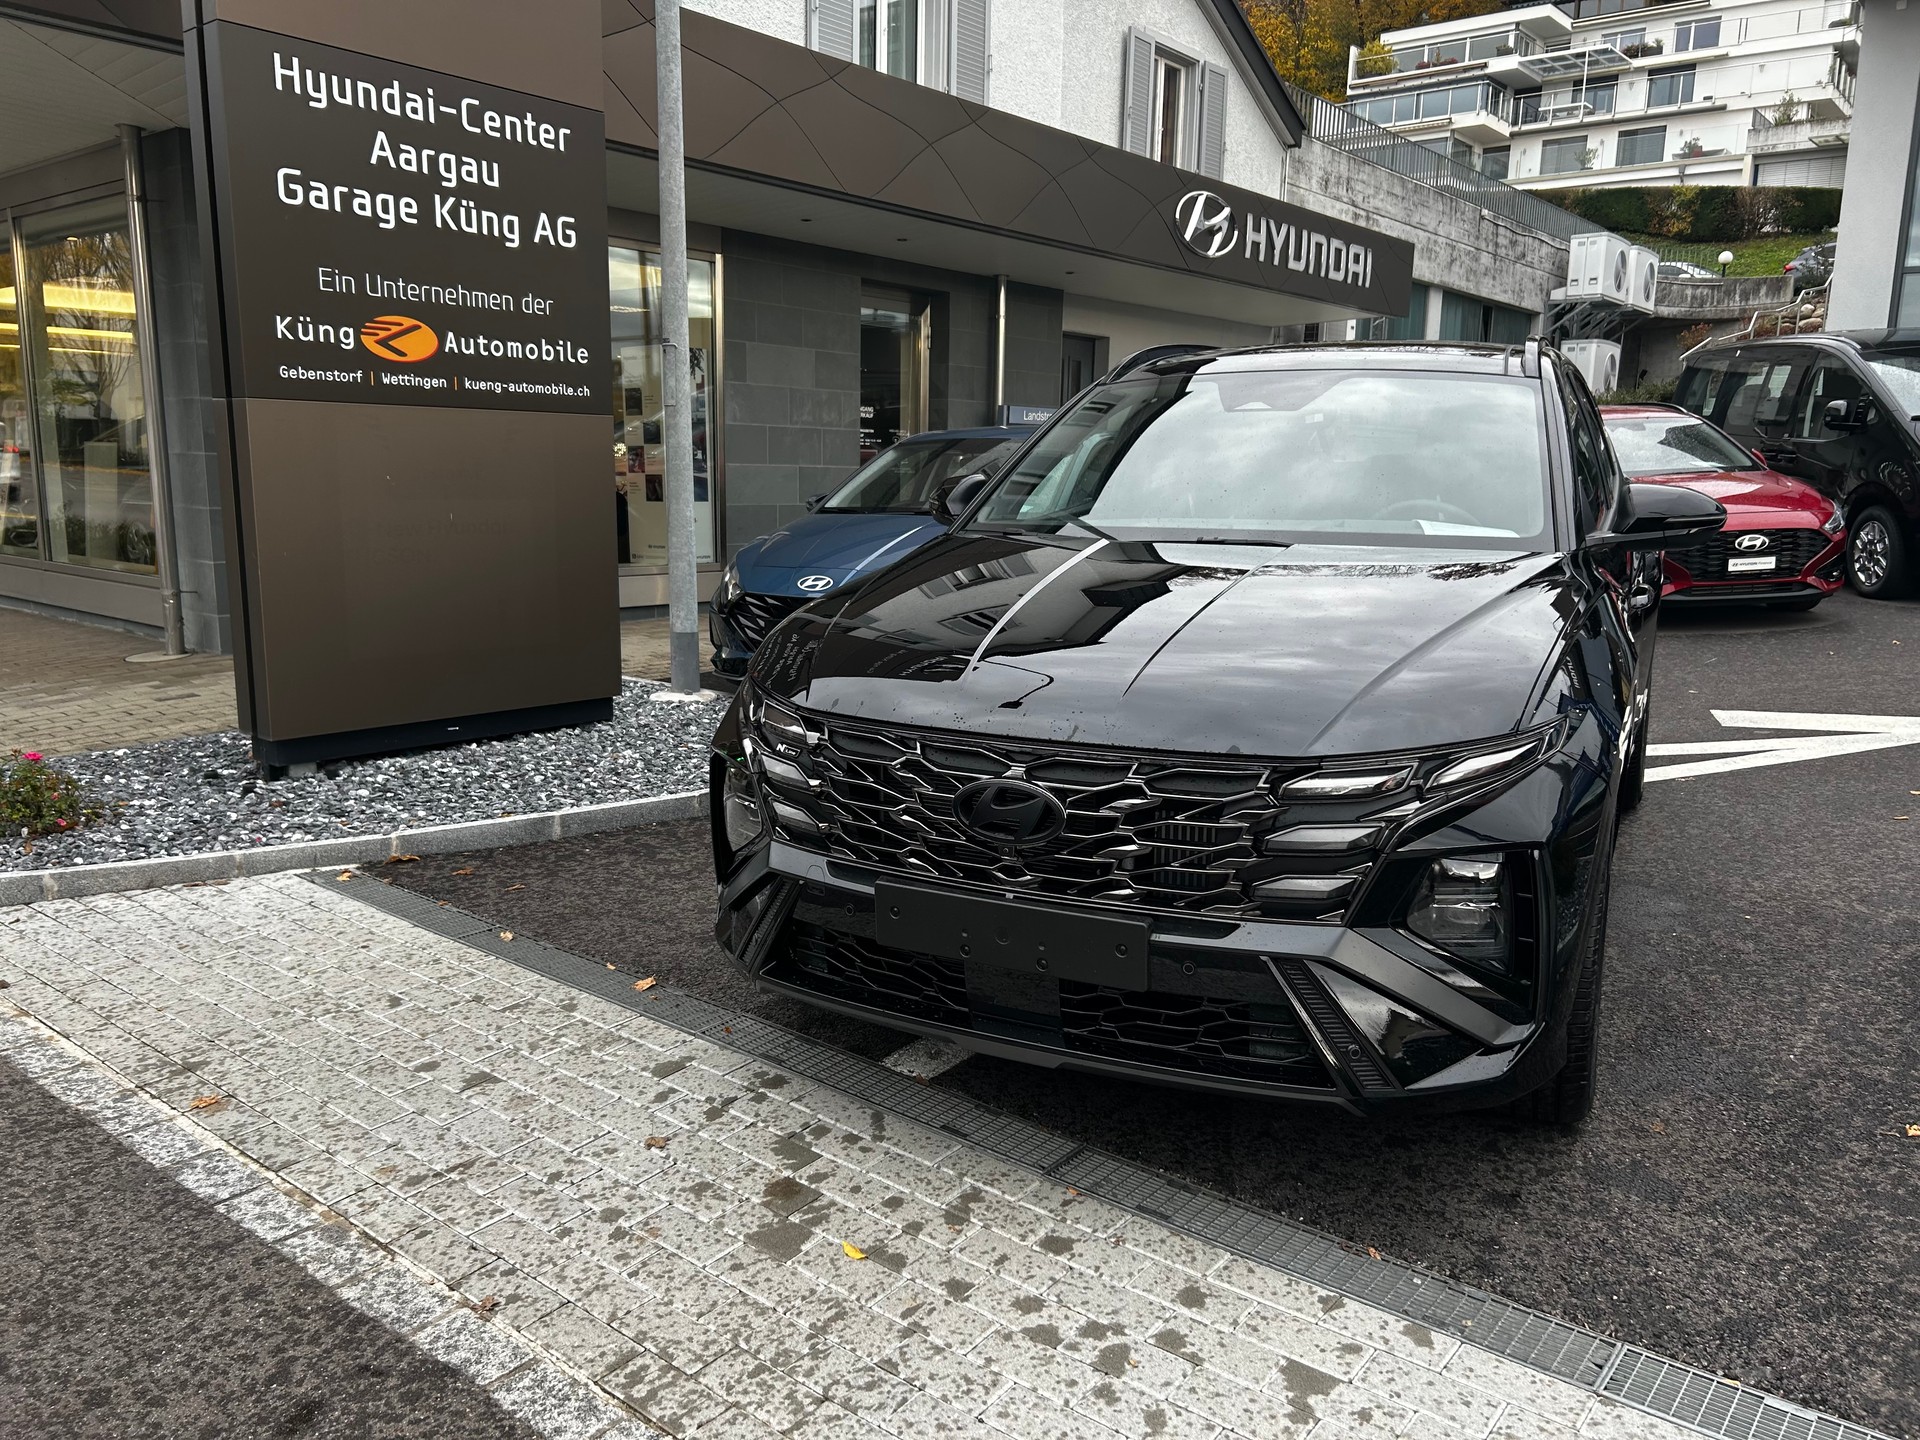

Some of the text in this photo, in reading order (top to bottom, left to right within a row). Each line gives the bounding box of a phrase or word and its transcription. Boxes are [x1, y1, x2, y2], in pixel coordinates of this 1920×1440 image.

[273, 51, 571, 152] Hyundai-Center
[369, 130, 500, 188] Aargau
[276, 167, 577, 249] Garage Küng AG
[1244, 212, 1373, 288] HYUNDAI
[318, 267, 554, 316] Ein Unternehmen der
[275, 315, 589, 364] Küng Automobile
[279, 365, 590, 397] Gebenstorf Wettingen kueng-automobile.ch
